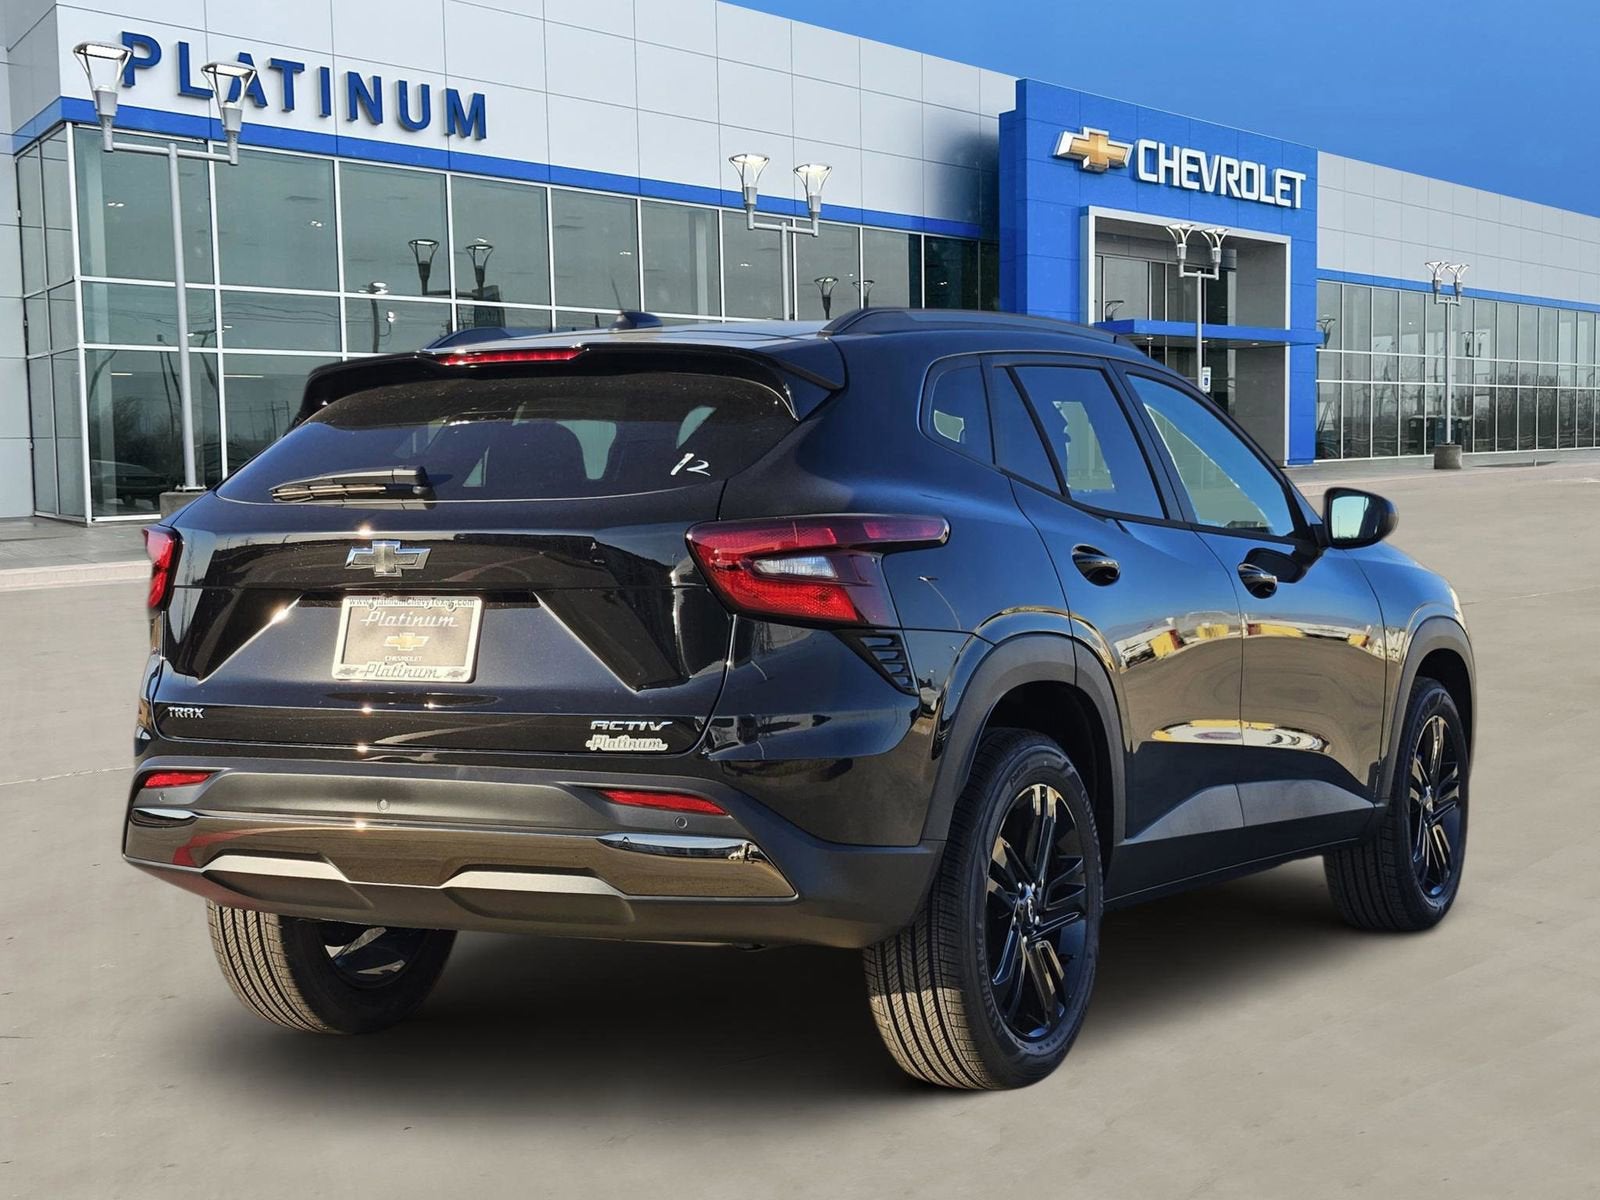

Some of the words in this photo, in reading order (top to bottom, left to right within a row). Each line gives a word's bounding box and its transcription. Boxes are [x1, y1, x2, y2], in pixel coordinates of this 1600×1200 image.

[120, 31, 487, 140] PLATINUM
[1135, 139, 1306, 209] CHEVROLET
[360, 611, 458, 627] Platinum
[359, 664, 442, 679] Platinum
[167, 706, 204, 718] TRAX
[590, 720, 673, 731] ACTIV
[585, 734, 669, 751] Platinum
